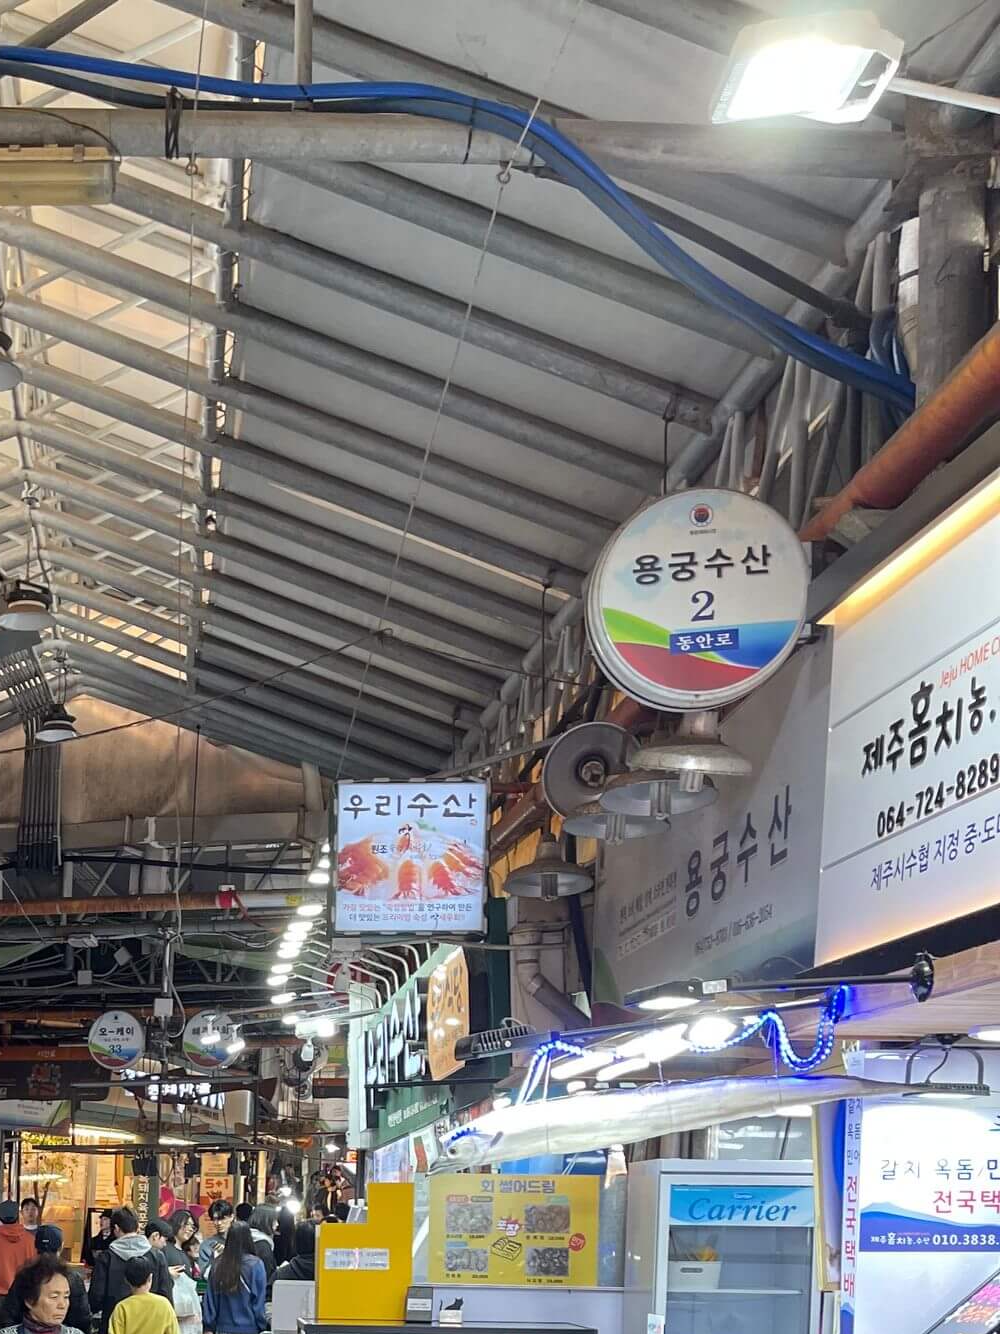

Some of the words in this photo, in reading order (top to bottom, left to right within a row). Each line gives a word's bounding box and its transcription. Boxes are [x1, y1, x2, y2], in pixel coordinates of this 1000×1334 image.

[632, 544, 772, 585] 용궁수산
[690, 590, 715, 622] 2
[676, 632, 734, 651] 동안로
[939, 666, 958, 688] Jeju
[959, 643, 991, 676] HOME
[343, 792, 477, 820] 우리수산
[876, 752, 1000, 838] 064-724-8289
[686, 784, 792, 918] 용궁수산
[870, 842, 930, 891] 제주시수협
[934, 829, 960, 865] 지정
[963, 812, 1000, 854] 중·도
[108, 1044, 122, 1054] 33
[880, 1159, 921, 1181] 갈치
[500, 1180, 556, 1194] 썰어드림
[688, 1198, 797, 1221] Carrier
[843, 1176, 858, 1298] 전국택배
